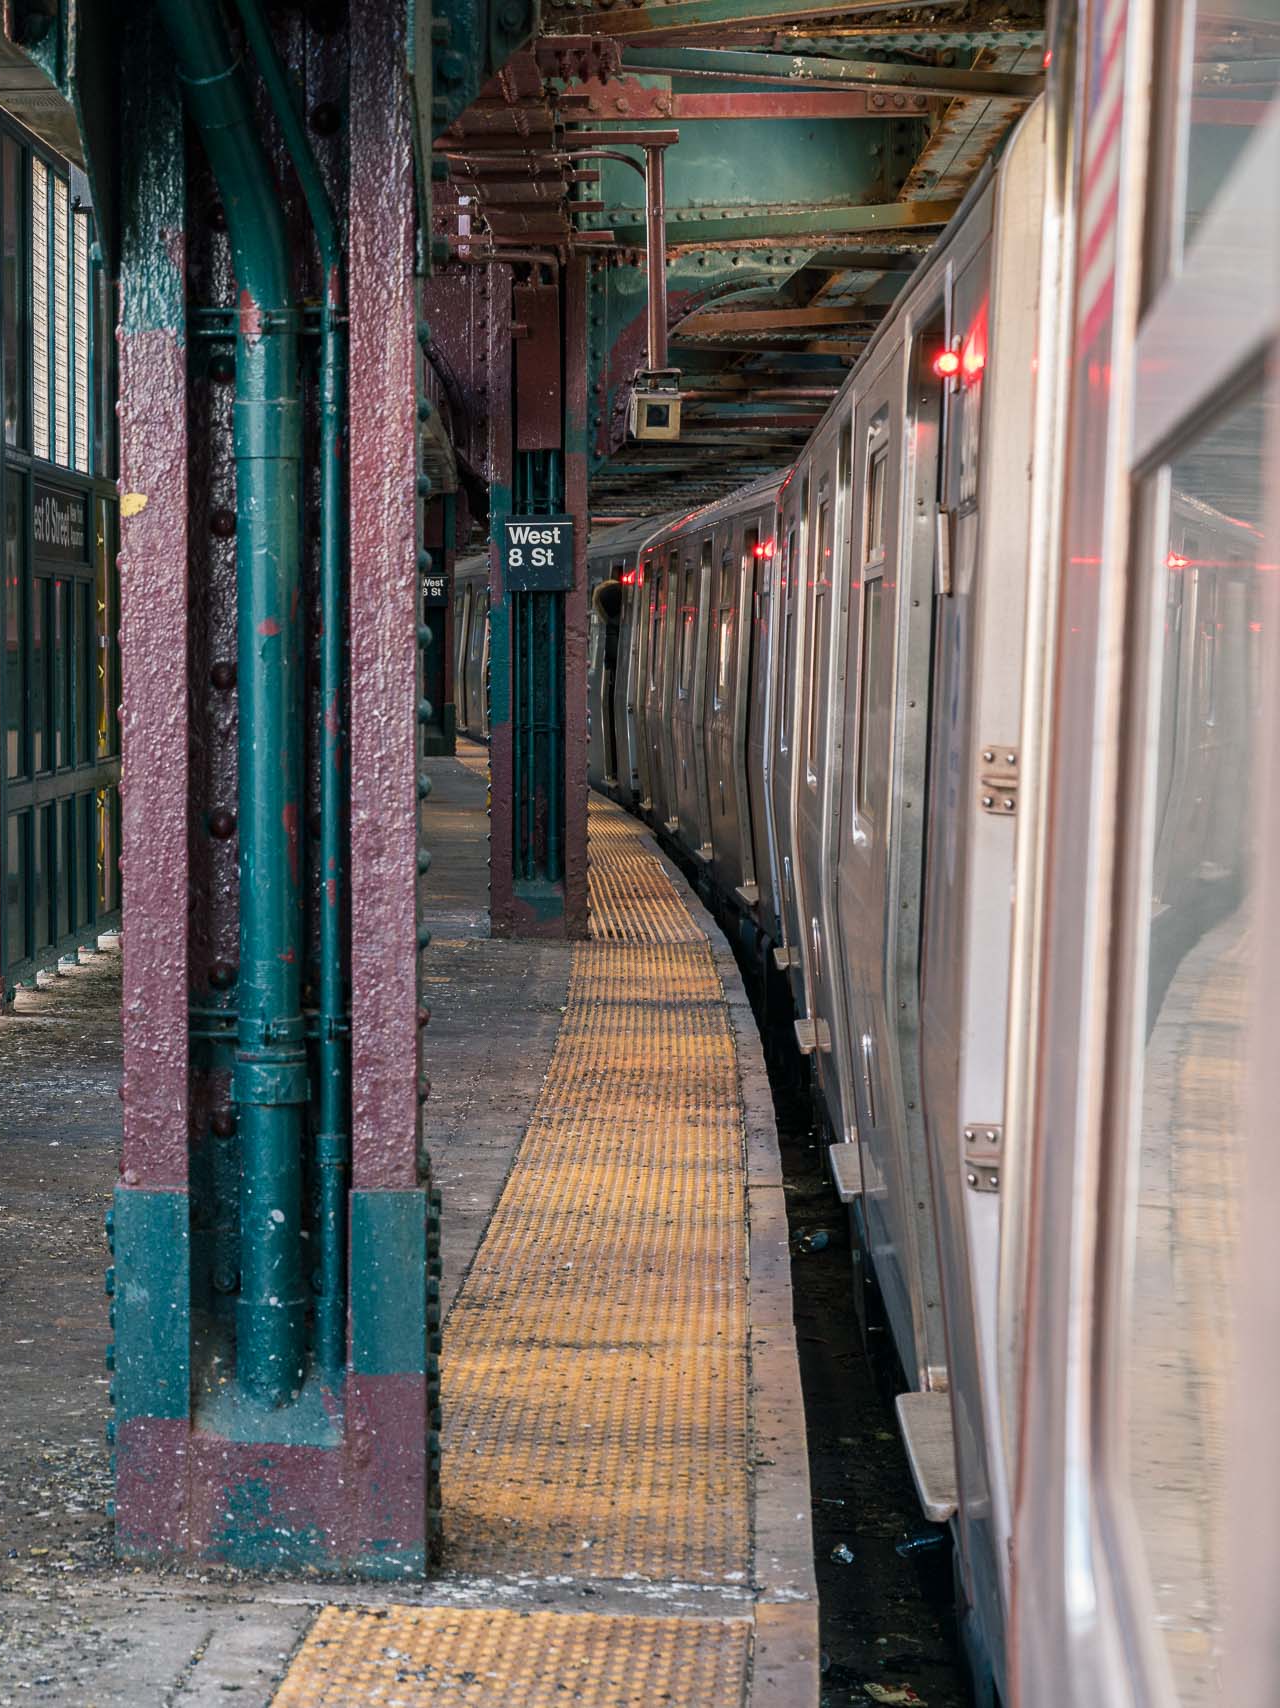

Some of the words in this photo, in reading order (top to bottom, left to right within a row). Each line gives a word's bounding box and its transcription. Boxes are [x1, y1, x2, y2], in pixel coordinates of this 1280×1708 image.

[45, 496, 50, 542] 8
[51, 497, 69, 548] Street
[508, 526, 561, 545] West
[508, 548, 523, 567] 8
[531, 548, 555, 566] St
[431, 587, 441, 597] St
